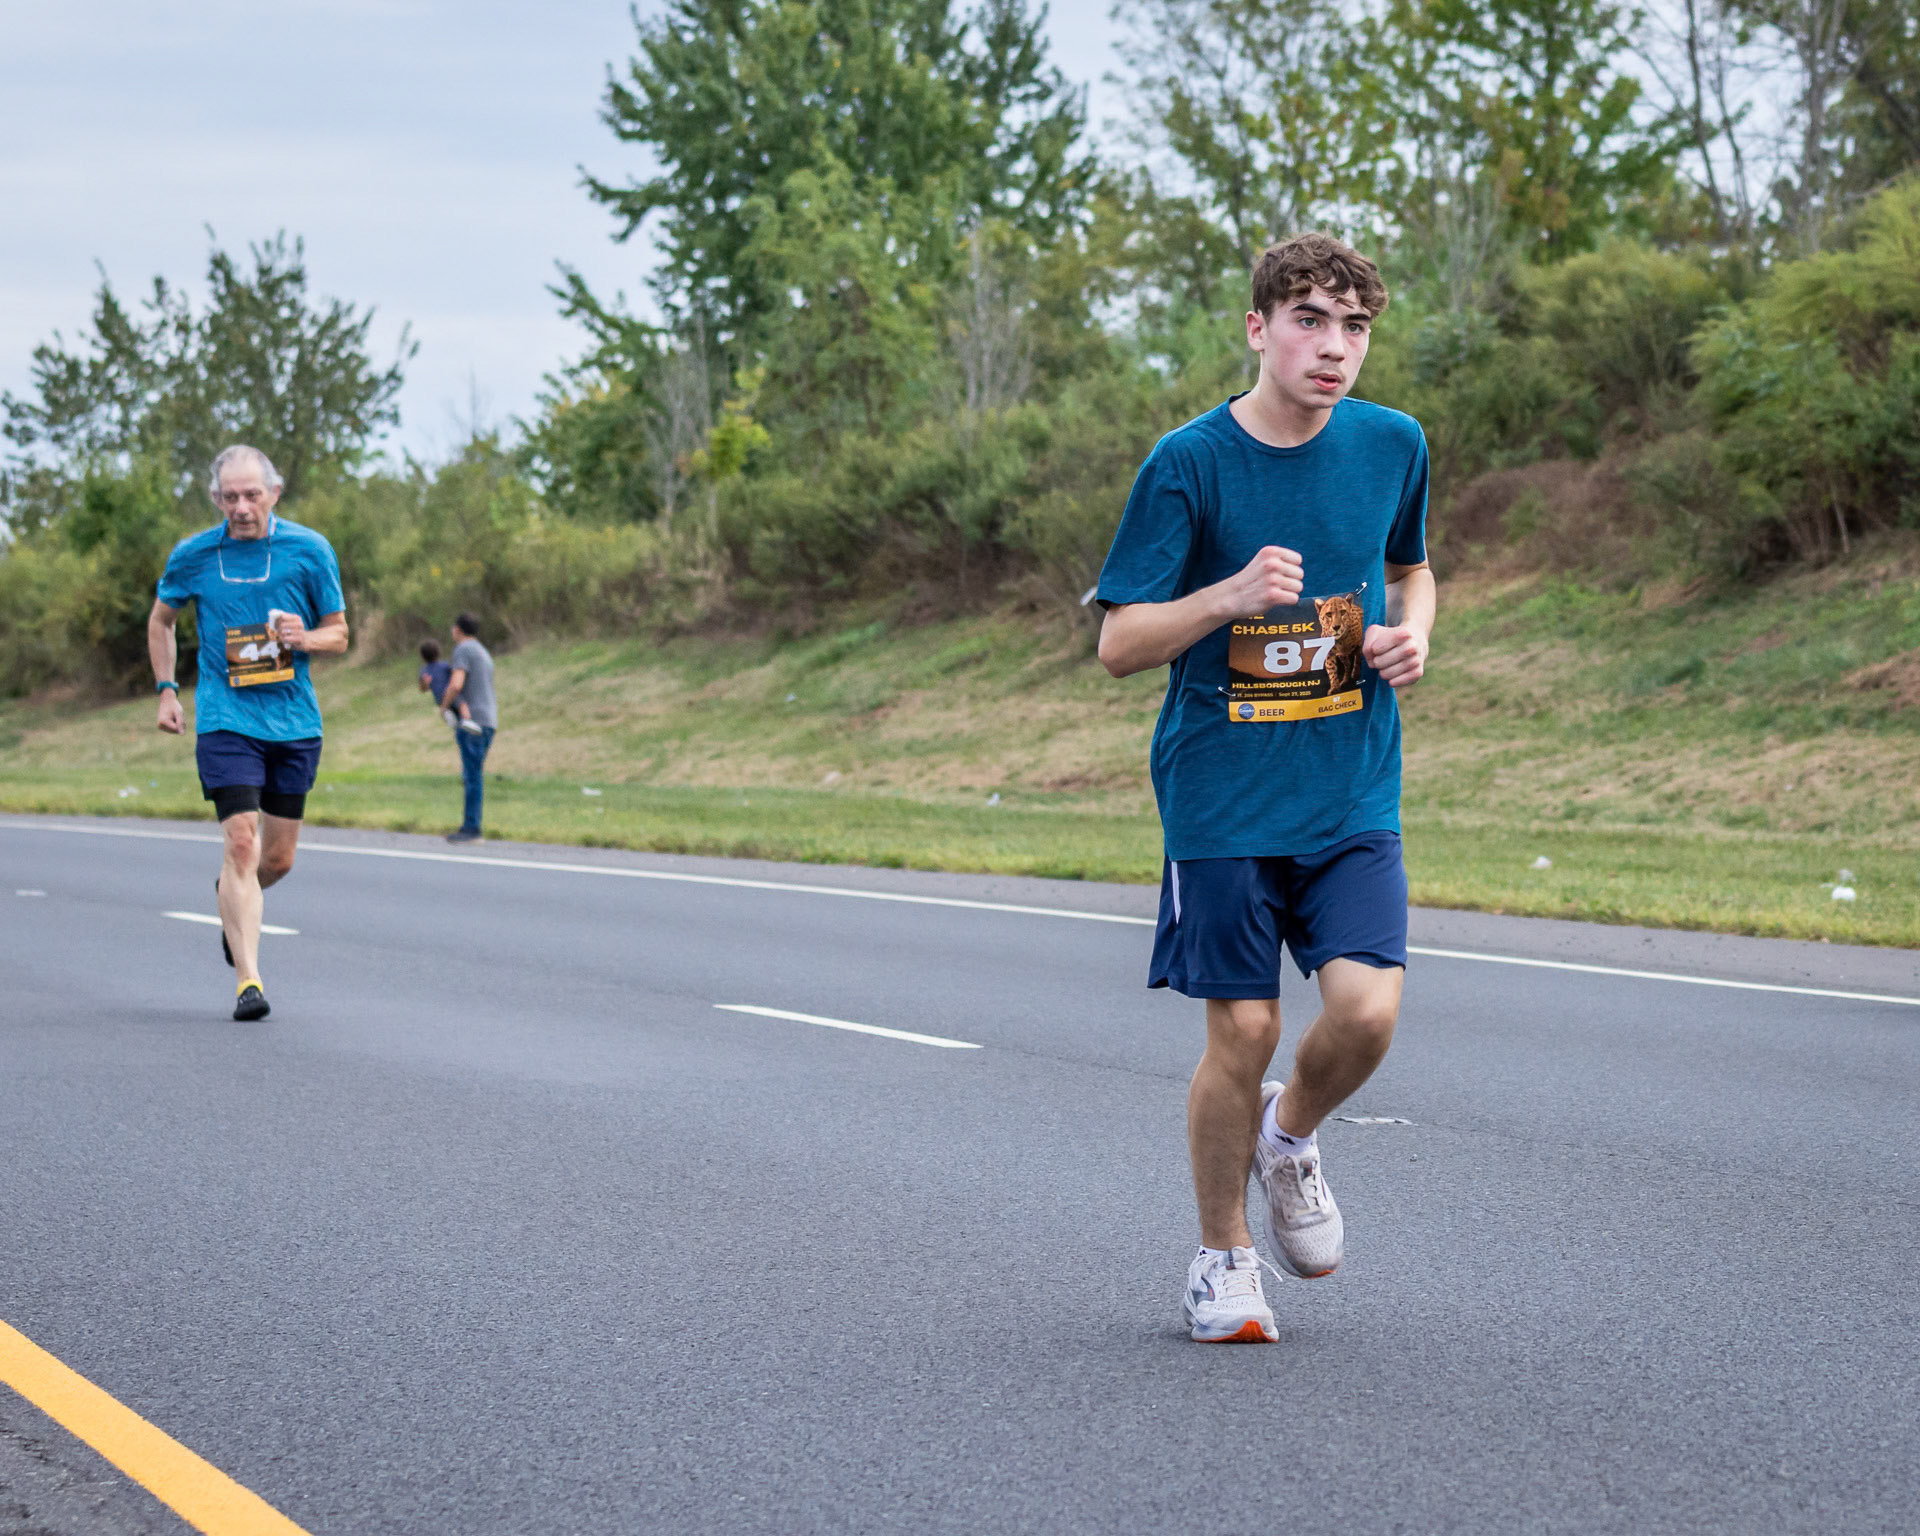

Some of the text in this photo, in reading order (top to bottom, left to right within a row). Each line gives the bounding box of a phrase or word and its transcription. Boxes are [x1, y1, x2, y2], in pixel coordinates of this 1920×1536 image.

[1232, 622, 1314, 634] CHASE 5K
[238, 642, 280, 662] 44
[1264, 636, 1336, 674] 87
[1335, 700, 1357, 710] CHECK
